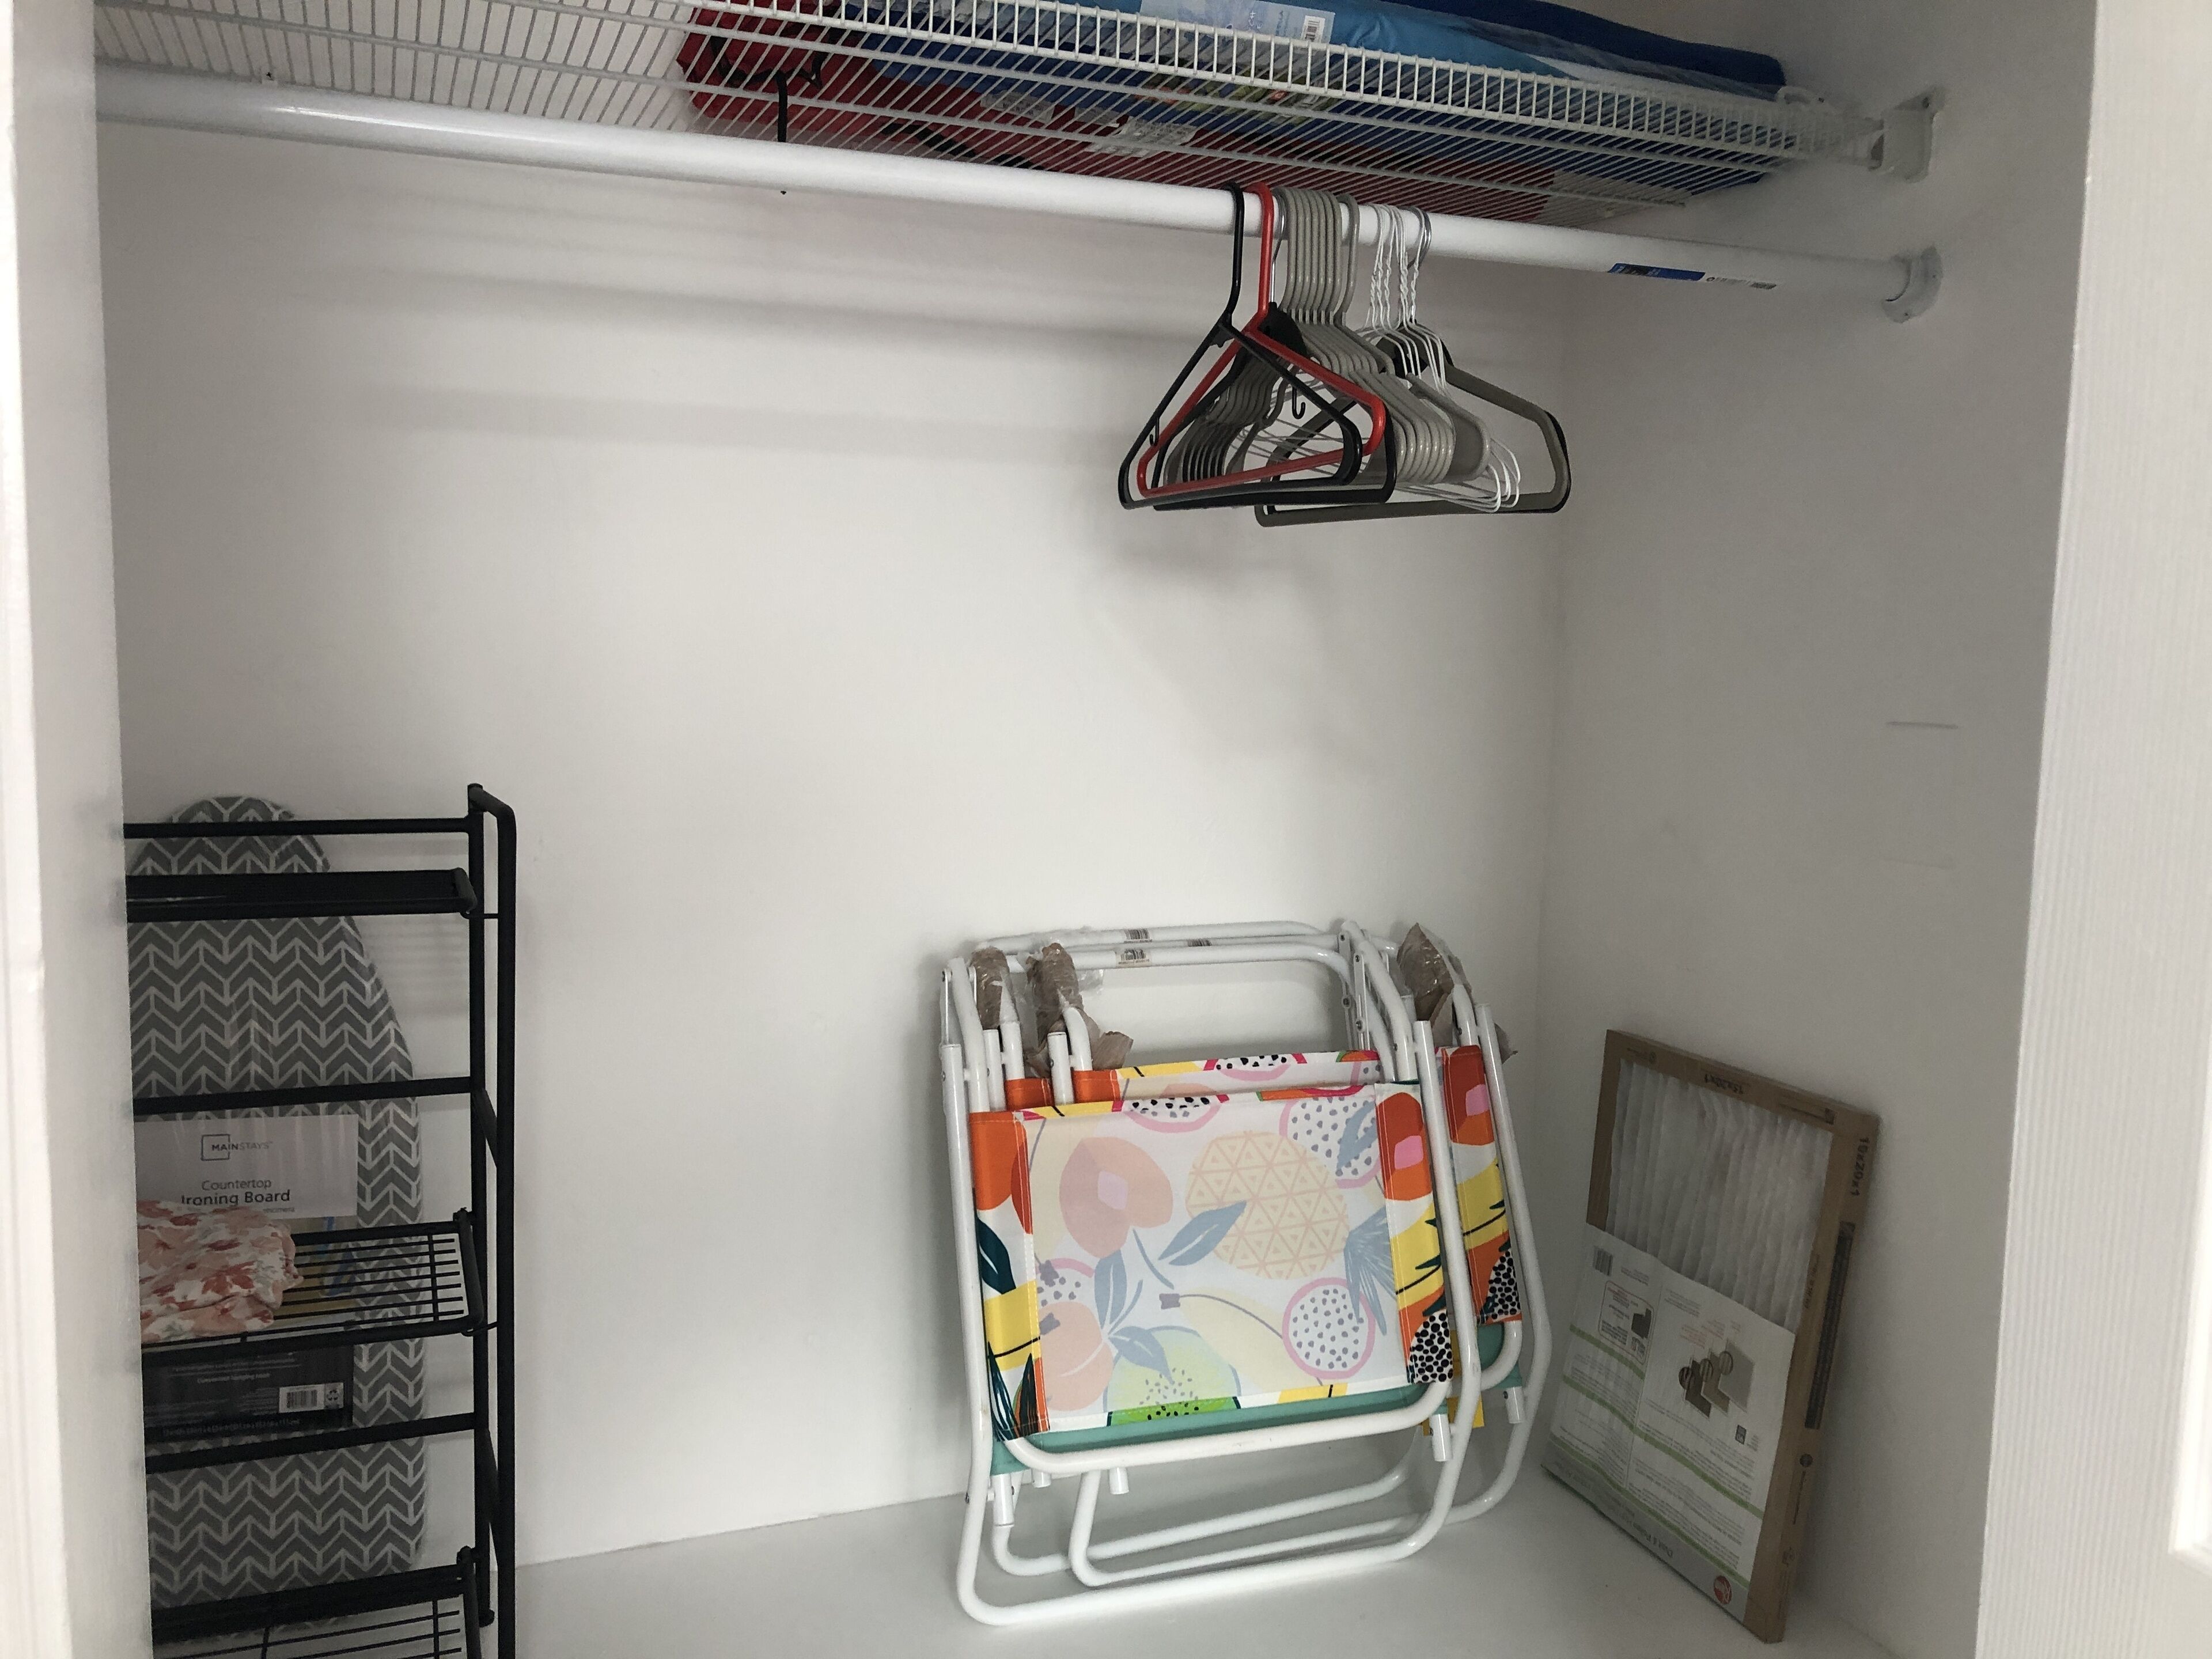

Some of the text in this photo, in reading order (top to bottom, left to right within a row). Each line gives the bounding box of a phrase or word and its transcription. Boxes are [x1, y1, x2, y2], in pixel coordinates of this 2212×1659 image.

[211, 1142, 270, 1152] MAINSTAYS
[202, 1180, 272, 1191] Countertop
[181, 1189, 290, 1207] Ironing Board
